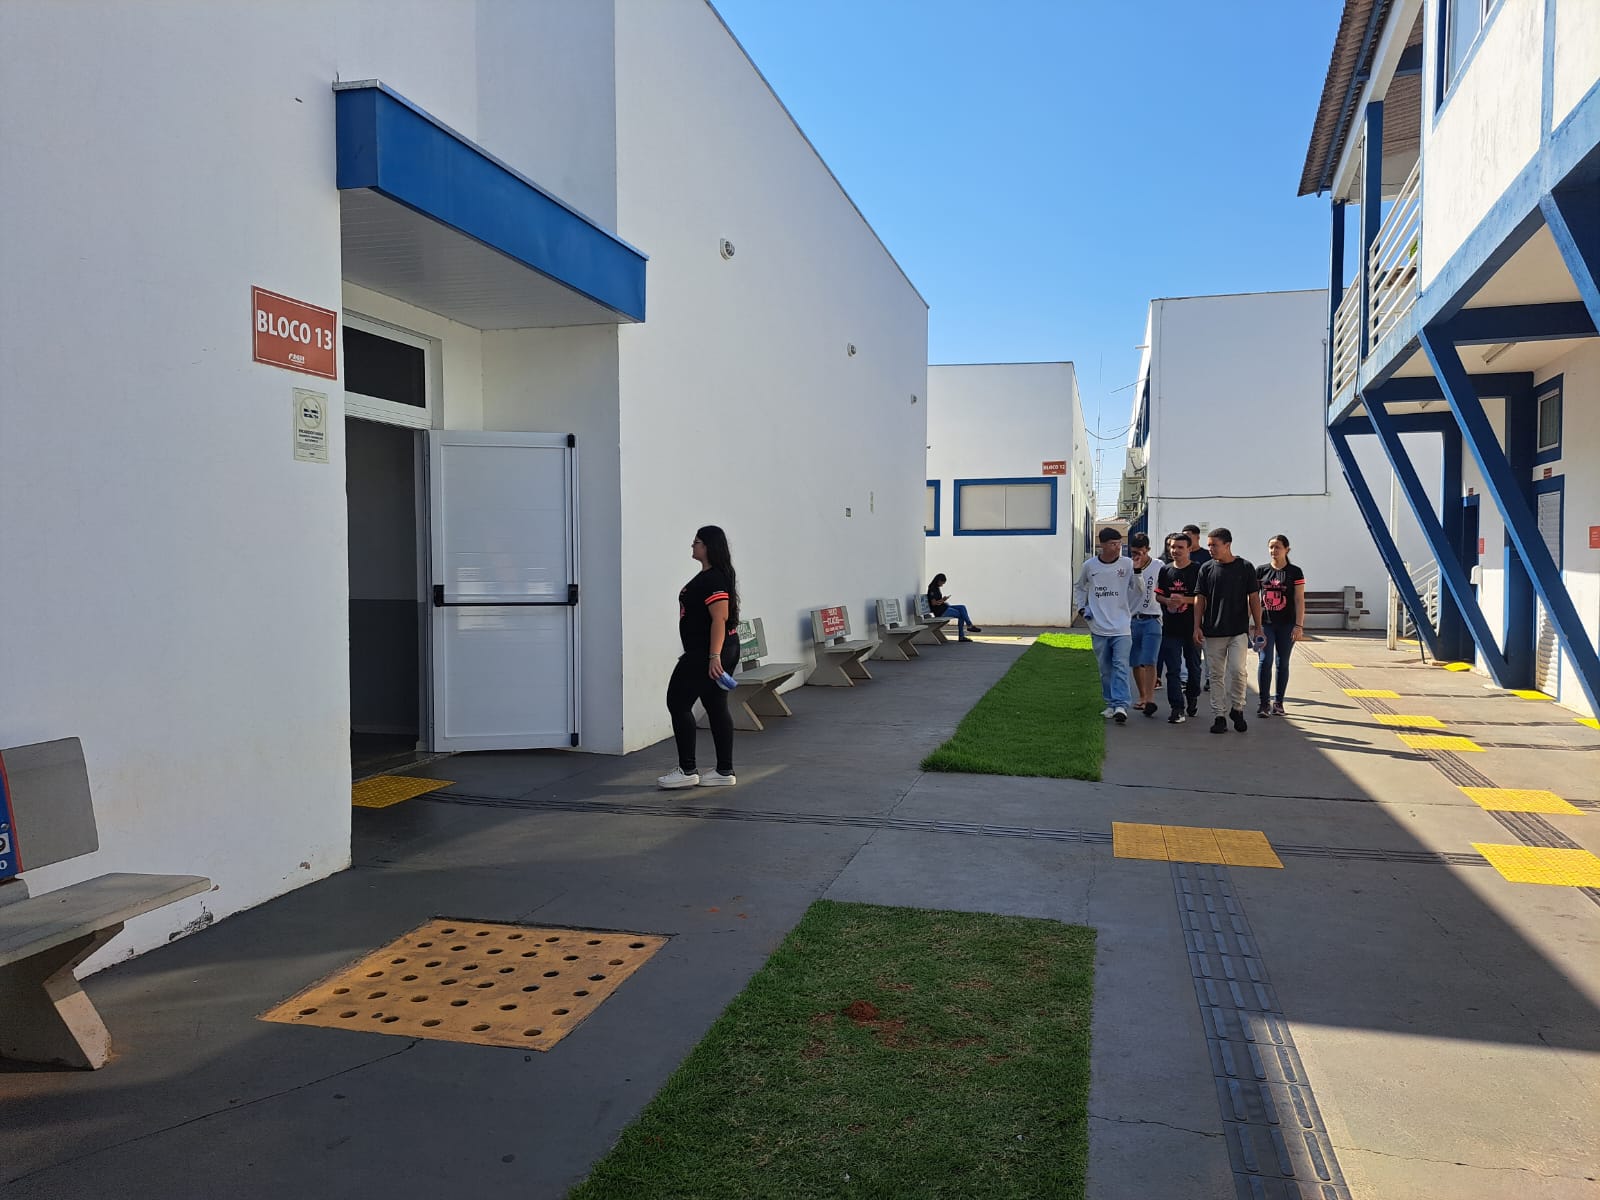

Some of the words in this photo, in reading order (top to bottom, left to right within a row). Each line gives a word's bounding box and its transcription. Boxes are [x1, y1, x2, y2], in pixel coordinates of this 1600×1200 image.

[257, 309, 311, 344] BLOCO
[315, 327, 333, 350] 13
[1142, 576, 1154, 608] ADELINO
